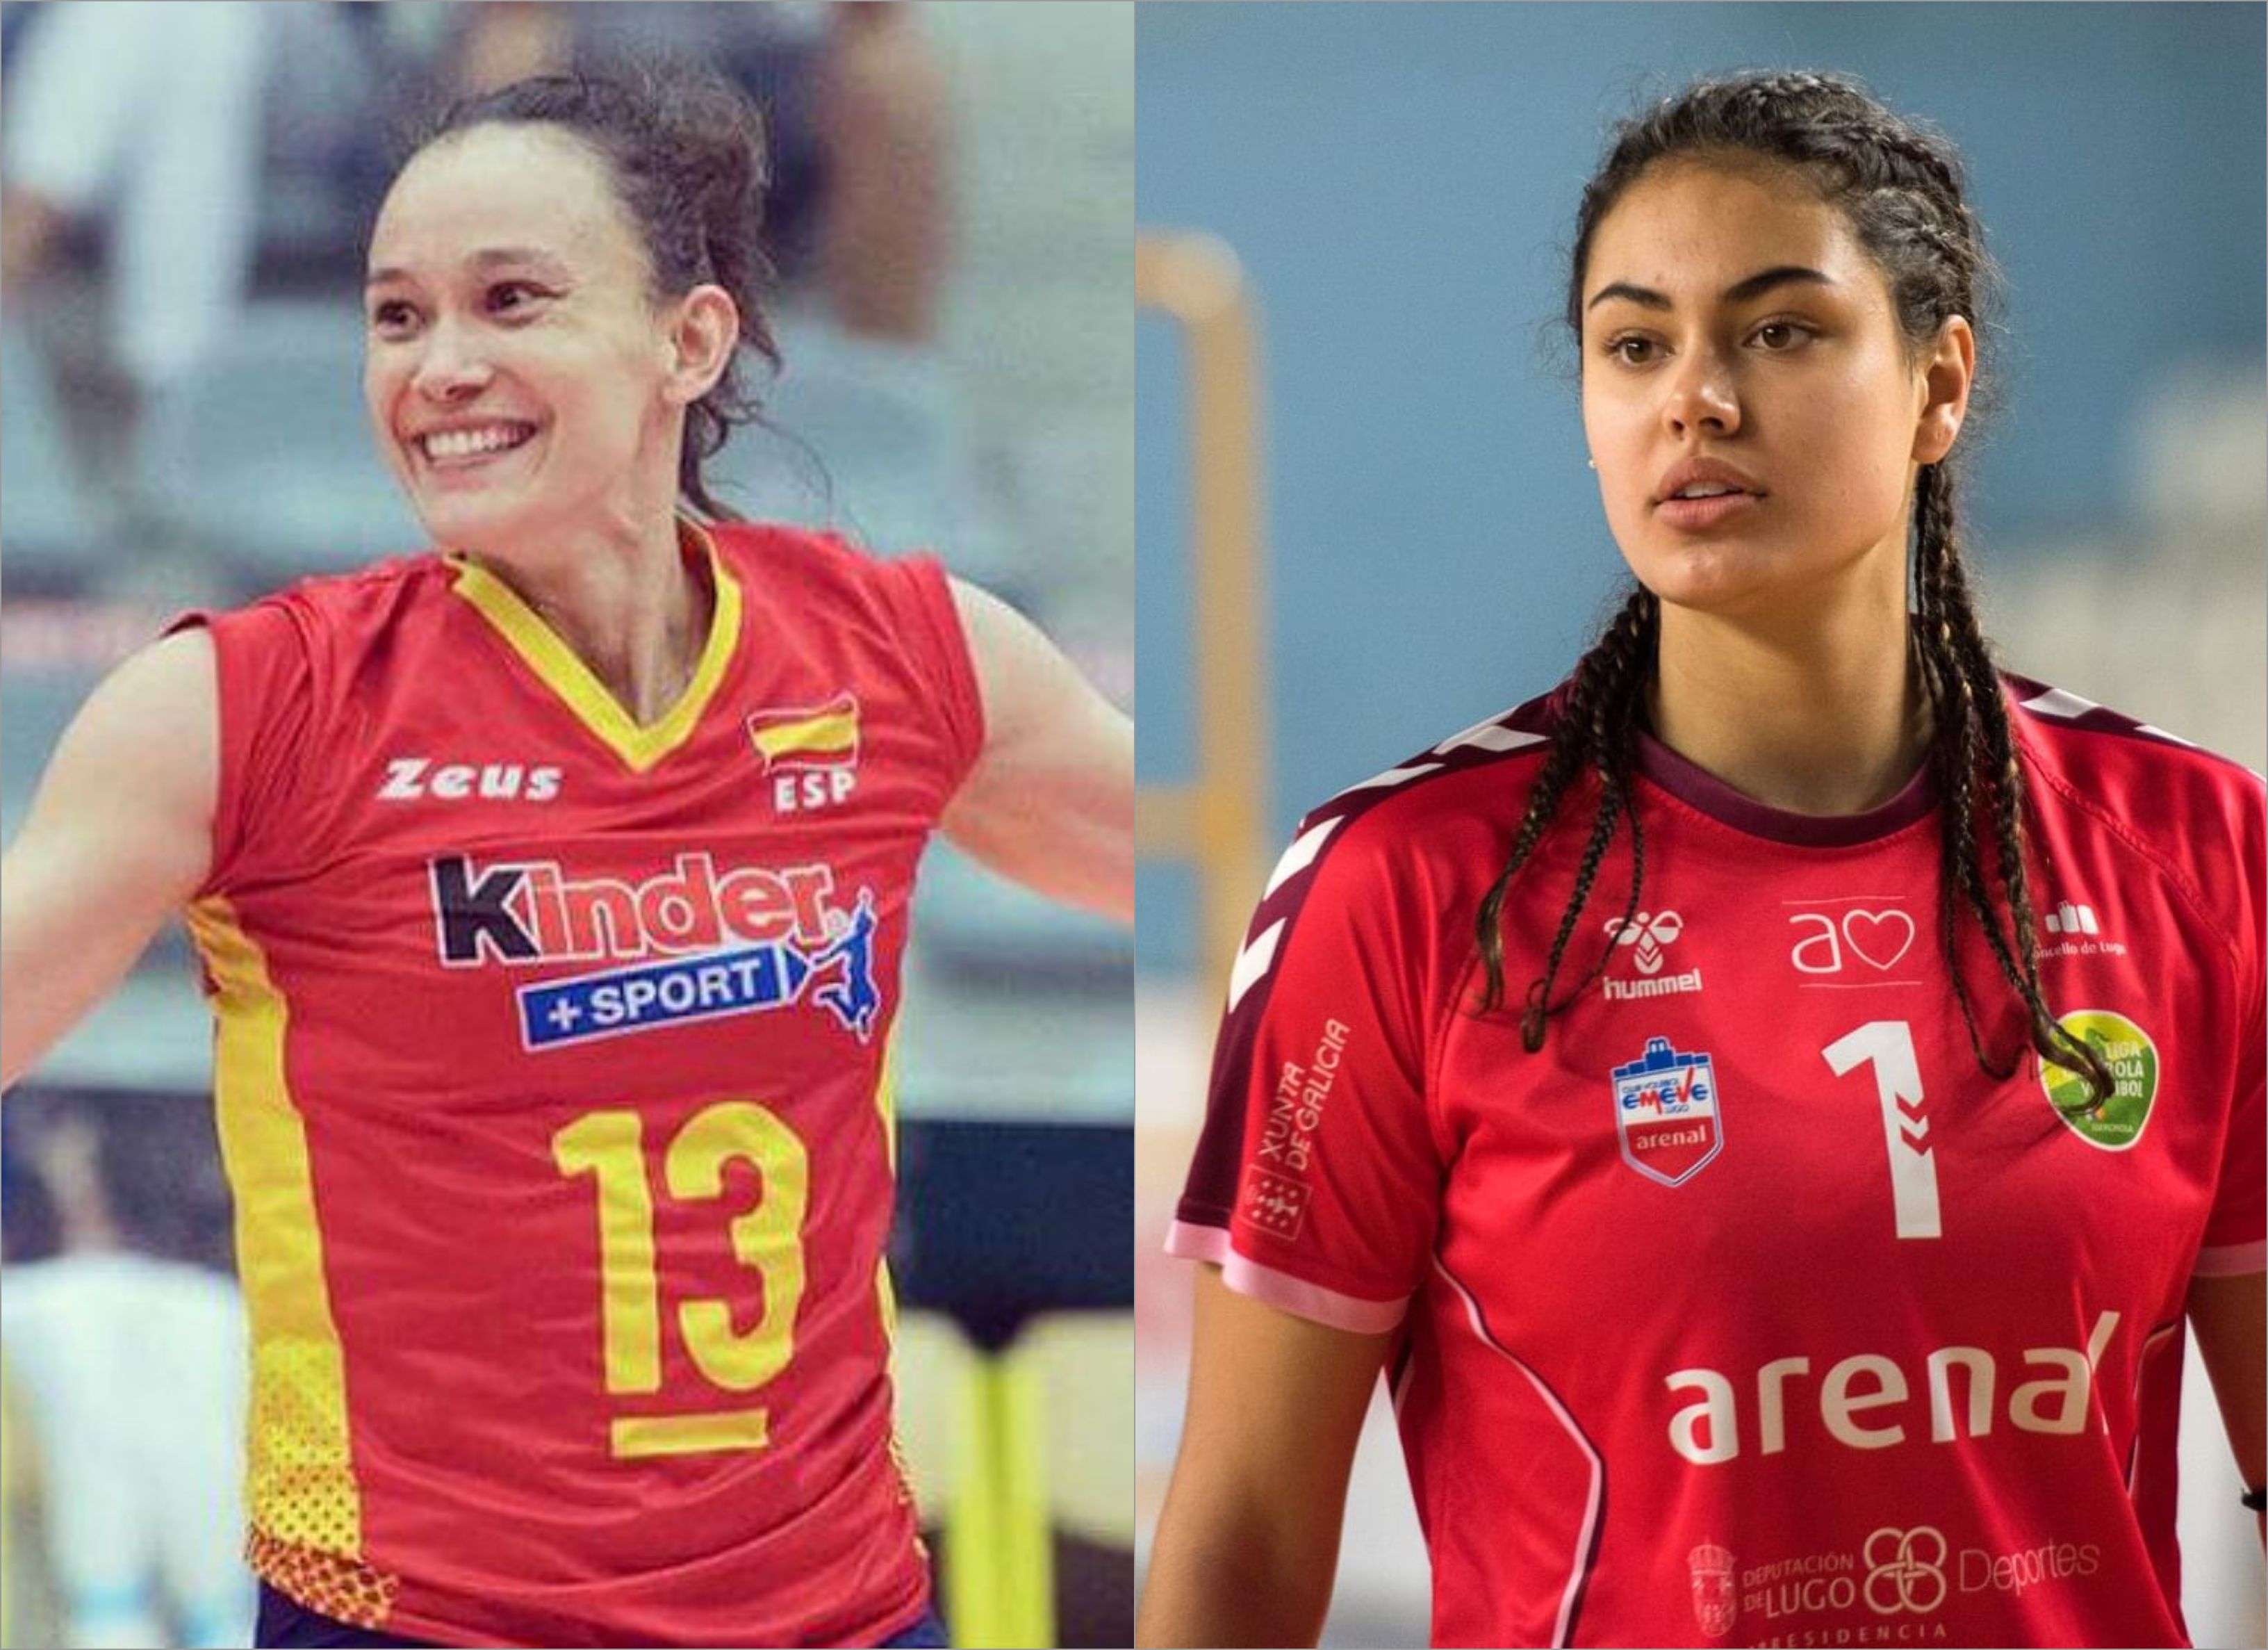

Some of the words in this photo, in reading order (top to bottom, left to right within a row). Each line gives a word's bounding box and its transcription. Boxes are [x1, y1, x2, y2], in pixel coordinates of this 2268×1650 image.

[375, 757, 564, 801] Zeus
[774, 771, 857, 812] ESP
[2032, 940, 2078, 958] oncello
[2081, 940, 2096, 955] de
[589, 959, 762, 1027] SPORT
[1602, 968, 1702, 999] hummel
[1295, 1018, 1351, 1132] GALICIA
[1258, 1061, 1305, 1161] XUNTA
[1821, 1020, 1942, 1240] 1
[1286, 1131, 1311, 1172] DE
[1636, 1123, 1707, 1150] arenal
[552, 1100, 810, 1396] 13
[1742, 1552, 1855, 1589] DEPUTACIÓN
[1959, 1542, 2101, 1596] Deportes
[1743, 1590, 1766, 1612] DE
[1765, 1576, 1855, 1619] LUGO
